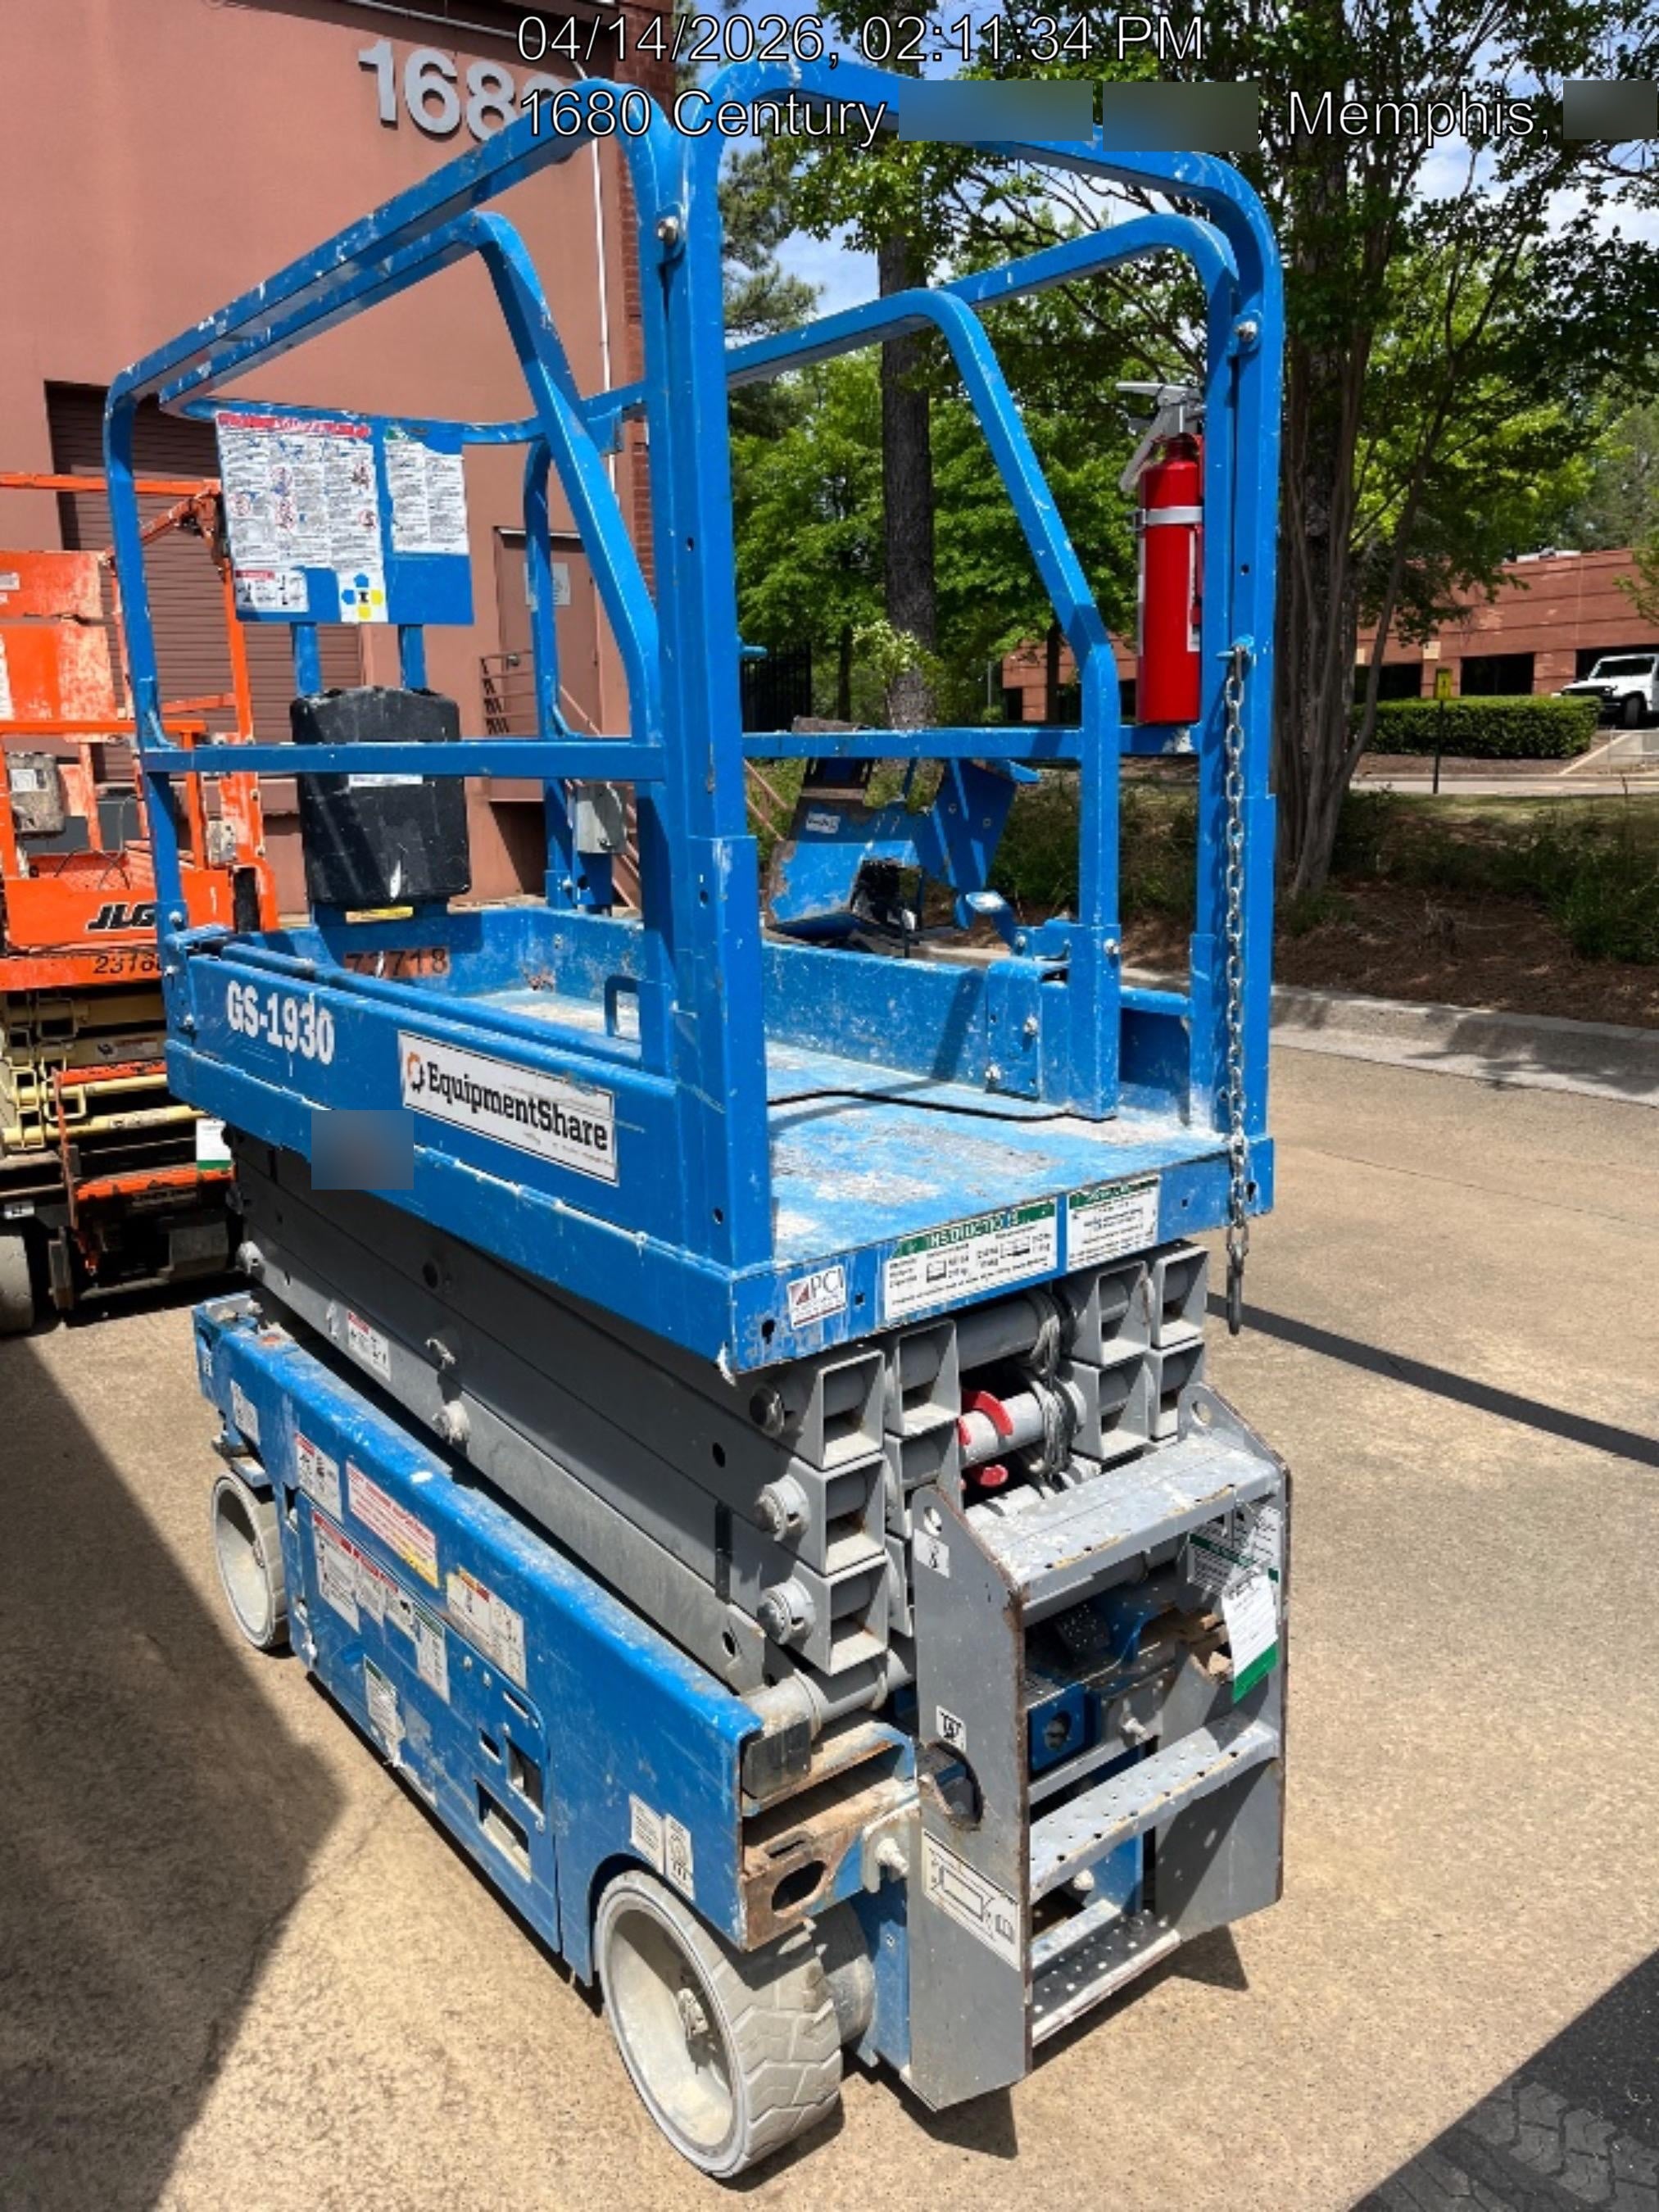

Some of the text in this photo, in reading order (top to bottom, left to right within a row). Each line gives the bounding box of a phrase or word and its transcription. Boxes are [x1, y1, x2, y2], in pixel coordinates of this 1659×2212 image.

[87, 903, 156, 930] JLG
[227, 979, 335, 1065] GS-1930
[427, 1061, 609, 1151] EquipmentShare
[809, 1267, 844, 1299] PCI
